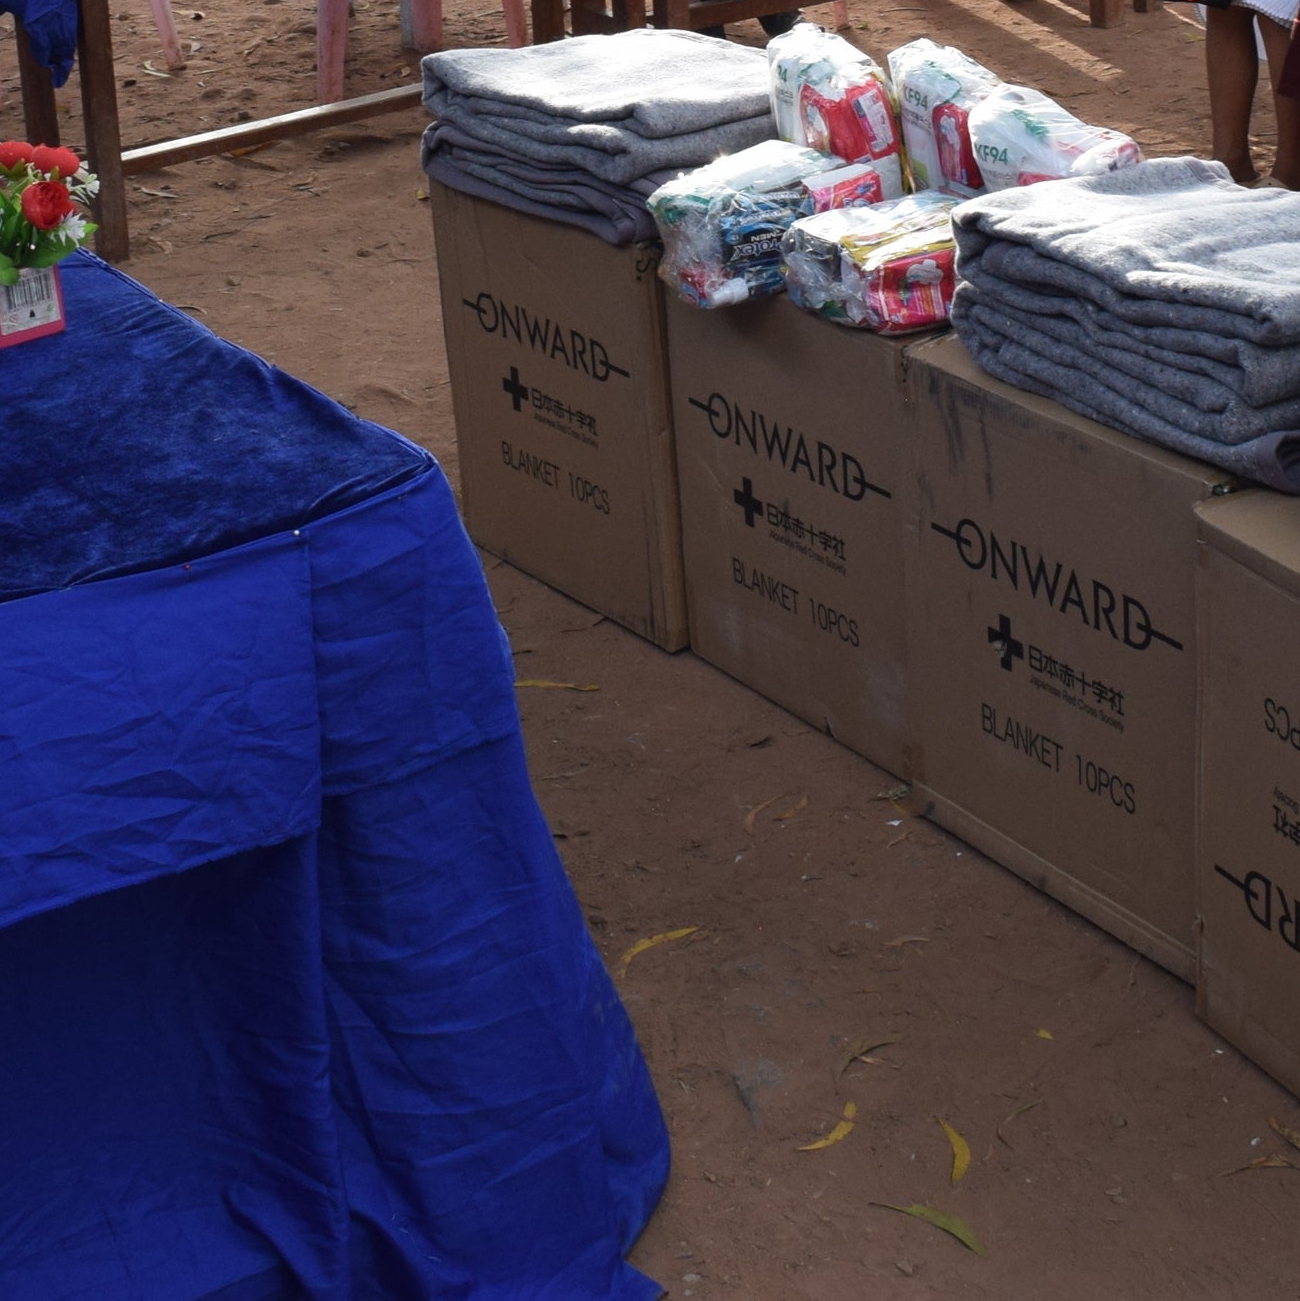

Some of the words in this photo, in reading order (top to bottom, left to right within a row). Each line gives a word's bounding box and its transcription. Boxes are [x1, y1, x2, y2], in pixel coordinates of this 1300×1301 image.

[974, 143, 1009, 167] KF94
[751, 231, 777, 242] MEN
[463, 293, 630, 381] ONWARD
[501, 441, 560, 488] BLANKET
[569, 472, 610, 514] 10PCS
[689, 393, 892, 501] ONWARD
[767, 503, 846, 561] 日本赤十字社
[733, 557, 799, 614] BLANKET
[810, 598, 860, 647] 10PCS
[931, 518, 1183, 651] ONWARD
[1029, 645, 1124, 716] 日本赤十字社
[982, 702, 1063, 772] BLANKET
[1076, 755, 1135, 814] 10PCS
